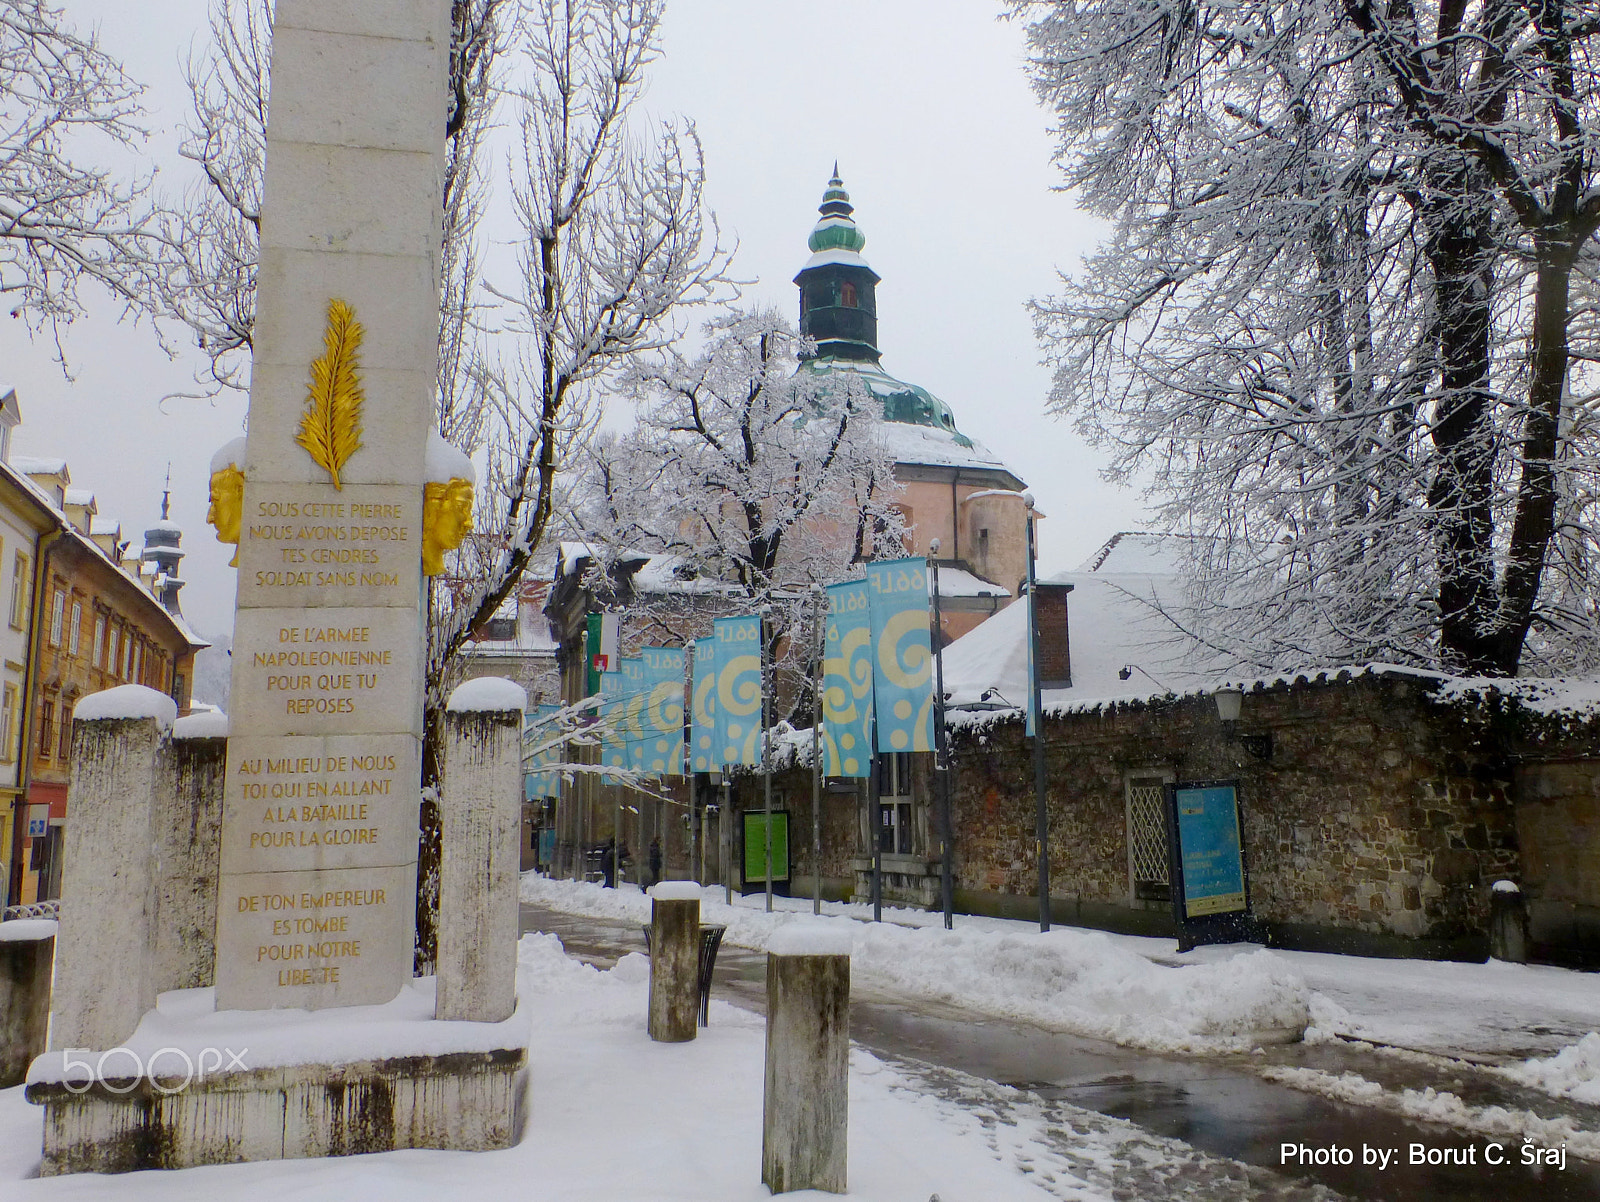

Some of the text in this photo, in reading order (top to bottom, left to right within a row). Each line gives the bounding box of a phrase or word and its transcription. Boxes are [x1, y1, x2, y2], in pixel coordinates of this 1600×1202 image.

[259, 502, 401, 519] SOUS CETTE PIERRE
[250, 526, 407, 541] NOUS AVONS DEPOSE
[281, 549, 379, 564] TES CENDRES
[256, 571, 399, 586] SOLDAT SANS NOM
[279, 628, 369, 642] DE L'ARMEE
[254, 651, 392, 666] NAPOLEONIENNE
[268, 674, 376, 690] POUR QUE TU
[287, 699, 354, 714] REPOSES
[239, 756, 396, 774] AU MILIEU DE NOUS
[242, 780, 392, 799] TOI QUI EN ALLANT
[263, 804, 367, 823] A LA BATAILLE
[250, 829, 378, 848] POUR LA GLOIRE
[238, 889, 386, 912] DE TON EMPEREUR
[273, 917, 348, 935] ES TOMBE
[258, 941, 360, 961] POUR NOTRE
